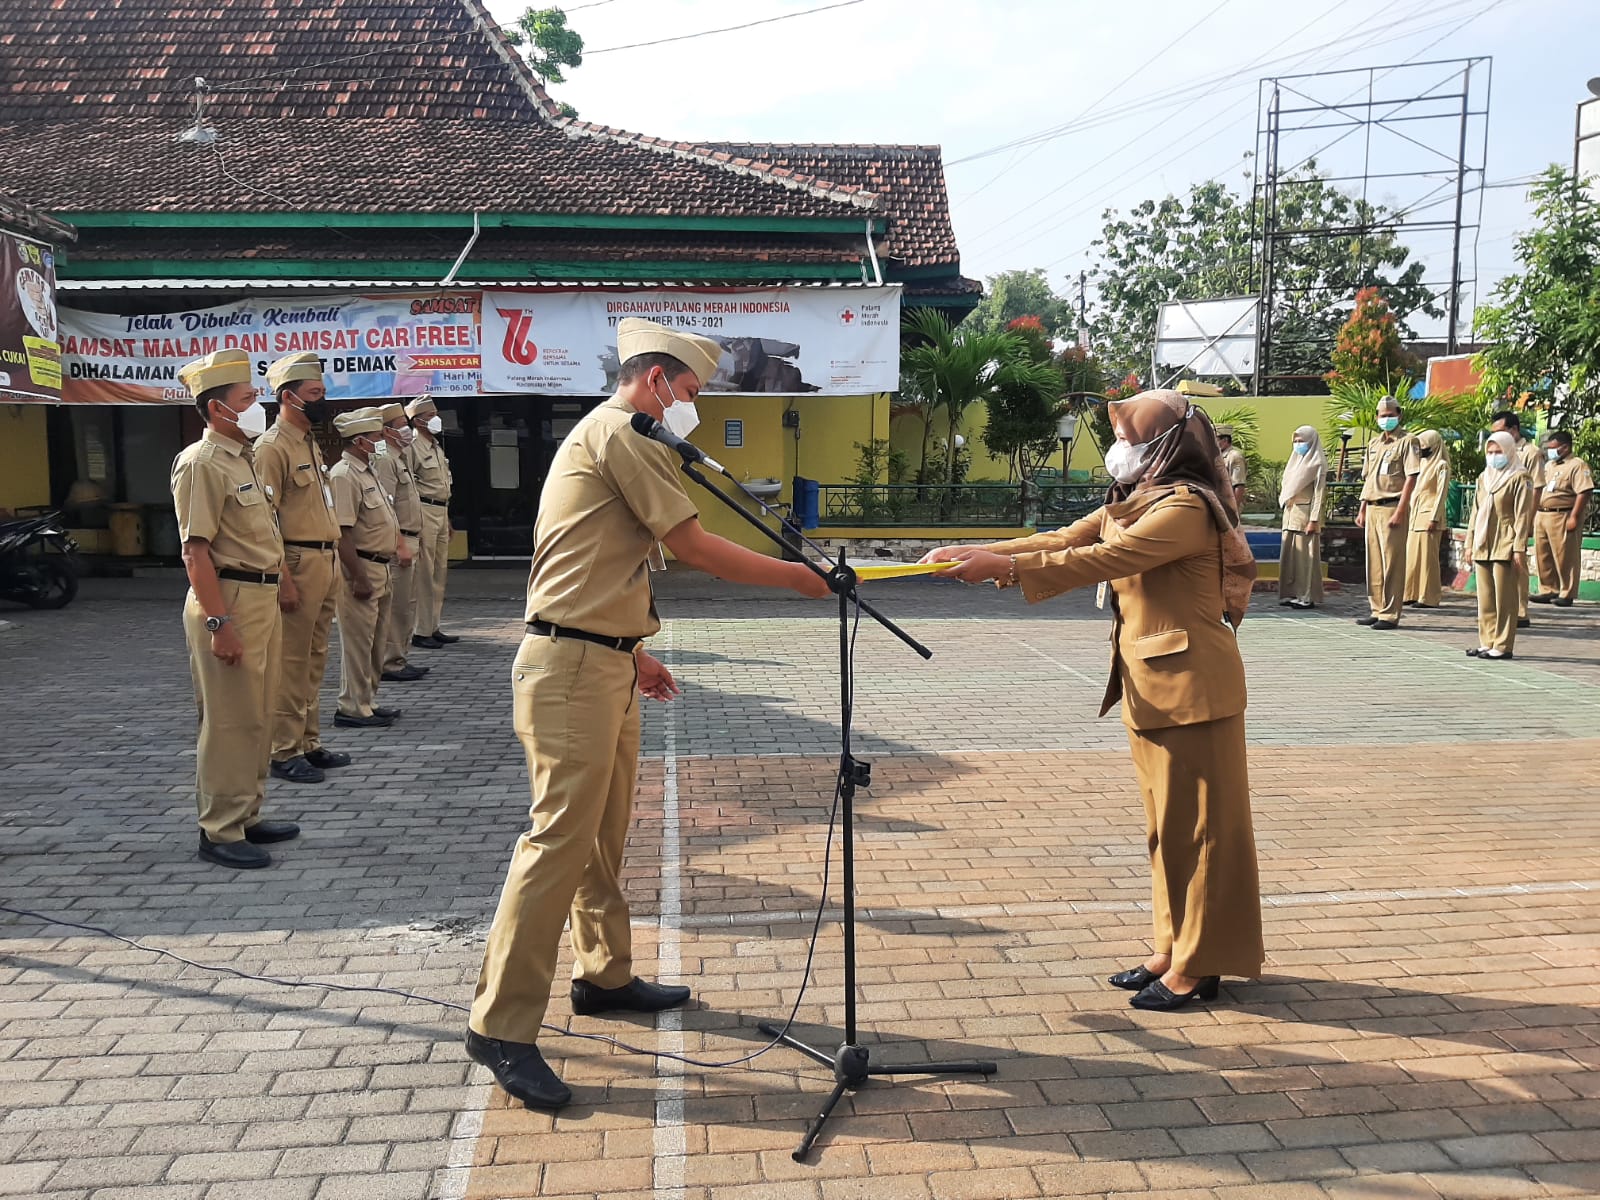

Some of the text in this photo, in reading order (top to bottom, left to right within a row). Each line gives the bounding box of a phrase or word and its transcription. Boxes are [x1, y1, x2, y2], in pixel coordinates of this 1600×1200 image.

[606, 301, 790, 314] DIRGAHAYU PALANG MERAH INDONESIA
[180, 312, 252, 331] Dibuka
[263, 307, 340, 327] Kembali
[607, 316, 617, 327] 17
[676, 316, 723, 328] 1945-2021
[57, 334, 136, 358] SAMSAT
[143, 336, 218, 358] MALAM
[225, 333, 267, 353] DAN
[275, 329, 359, 352] SAMSAT
[366, 327, 409, 348] CAR
[416, 325, 470, 346] FREE
[496, 308, 538, 365] 76
[2, 349, 26, 365] CUKAI
[333, 355, 397, 373] DEMAK
[417, 357, 479, 367] SAMSAT CAR
[70, 361, 175, 380] DIHALAMAN
[443, 372, 464, 380] Hari
[424, 384, 442, 392] Jam
[449, 384, 473, 392] 06.00
